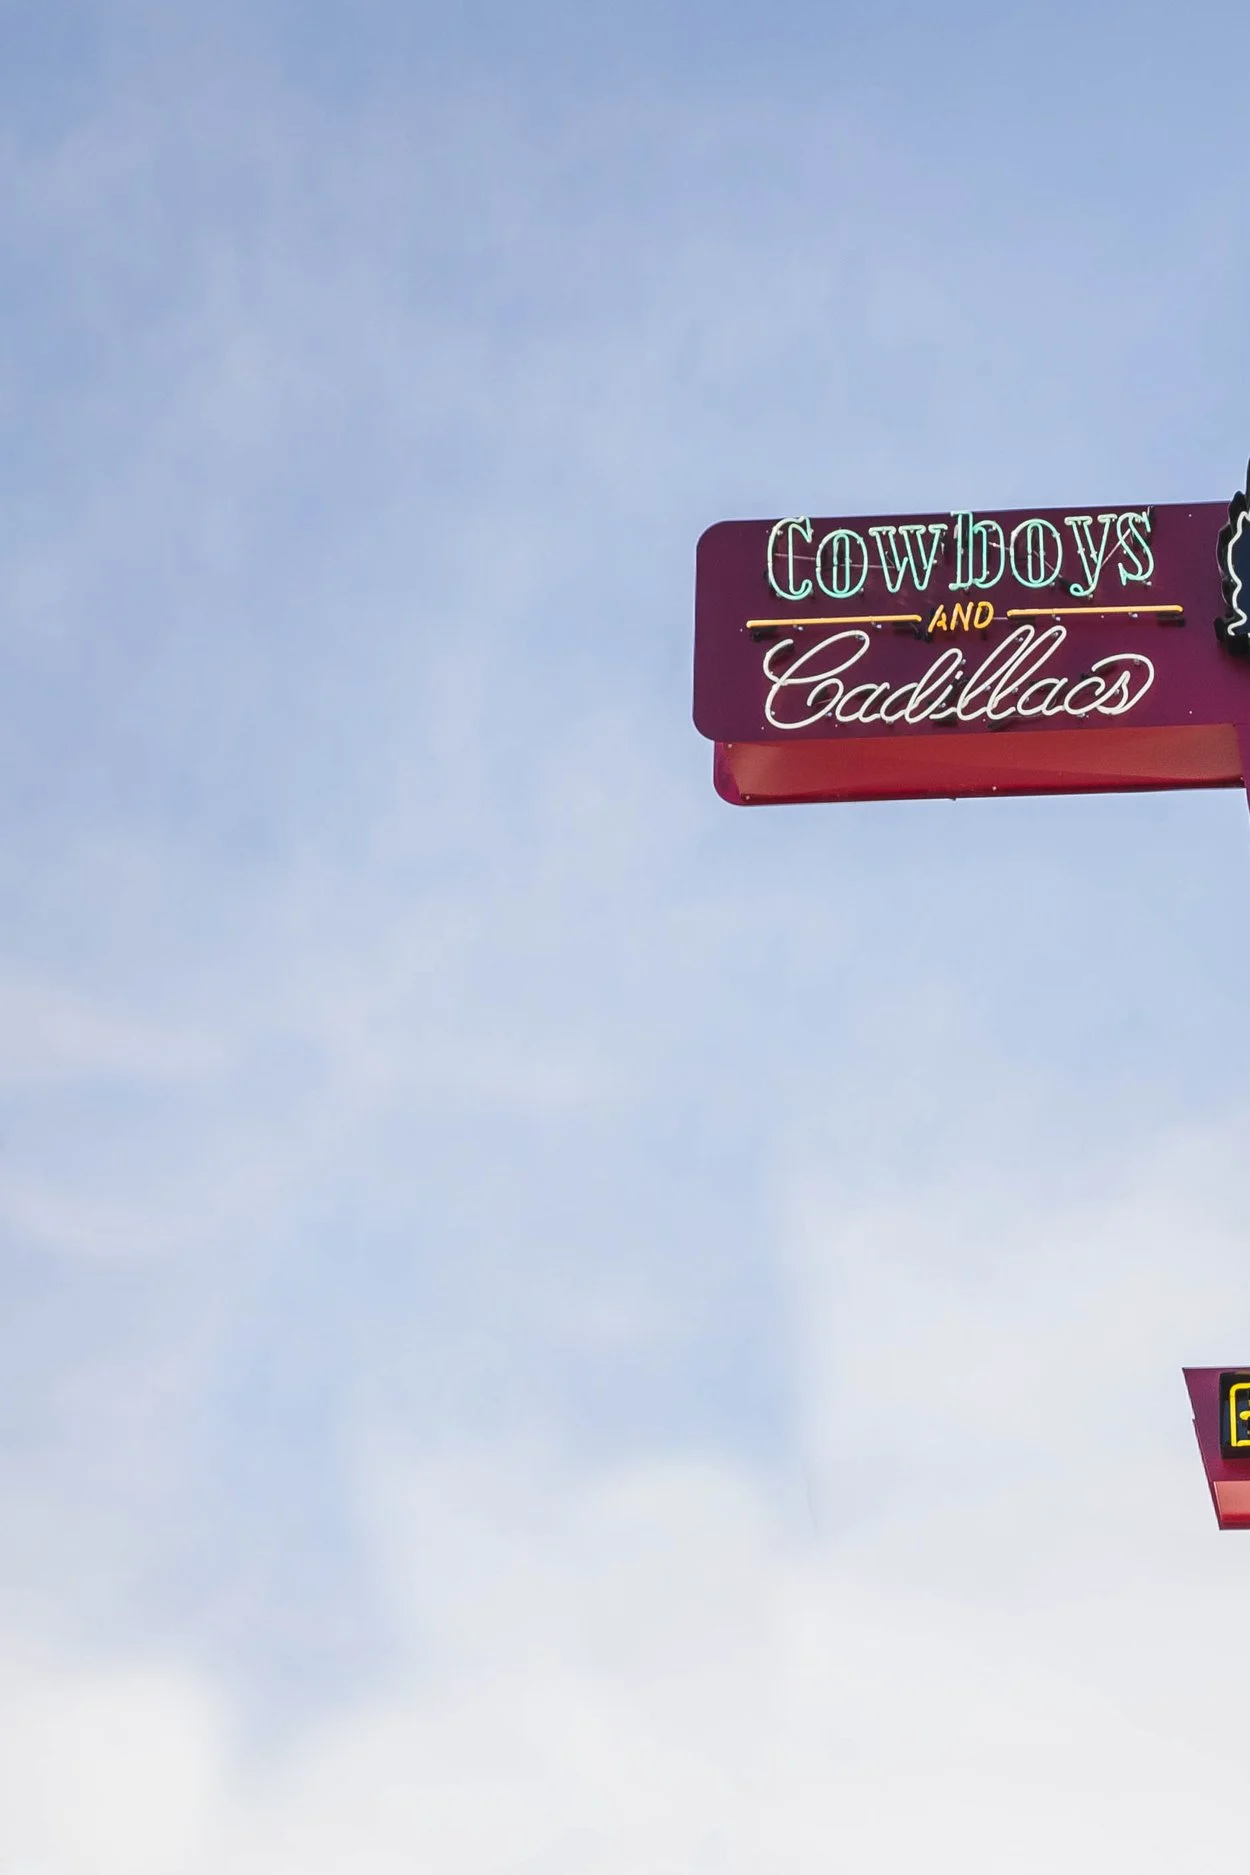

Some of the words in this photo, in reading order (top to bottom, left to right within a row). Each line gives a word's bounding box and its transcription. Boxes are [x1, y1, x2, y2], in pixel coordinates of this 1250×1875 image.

[766, 510, 1155, 601] Cowboys
[927, 600, 995, 633] AND
[762, 624, 1155, 730] Cadillacs
